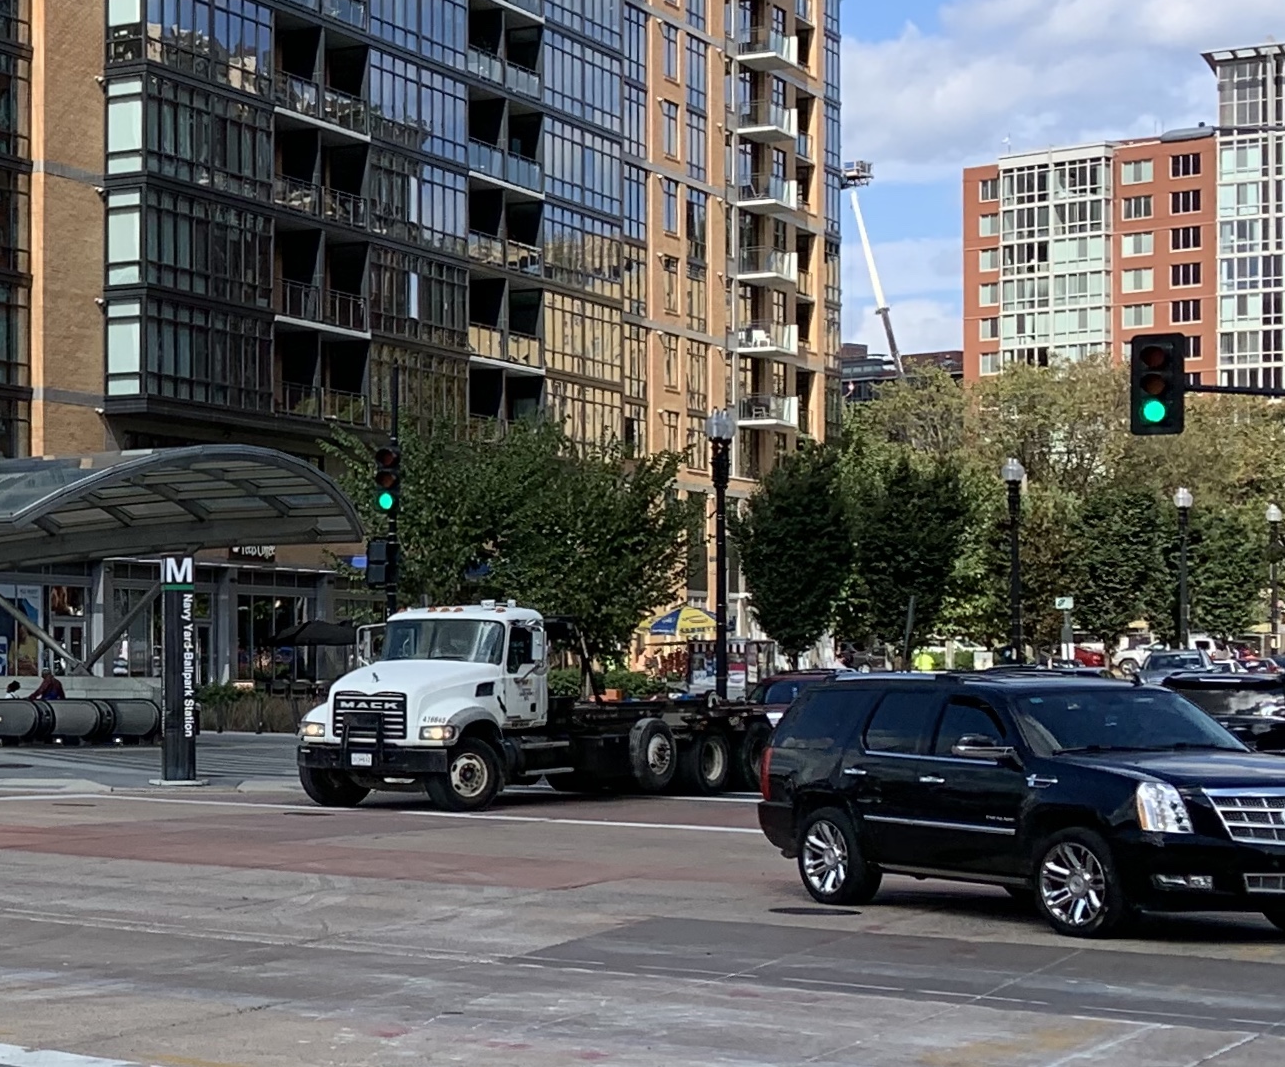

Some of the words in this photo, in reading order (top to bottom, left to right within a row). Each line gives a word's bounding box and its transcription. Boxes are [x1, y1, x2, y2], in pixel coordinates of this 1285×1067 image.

[166, 557, 193, 583] M
[181, 593, 193, 622] Navy
[182, 624, 194, 697] Yard-Ballpark
[184, 699, 194, 737] Station
[340, 701, 399, 709] MACK
